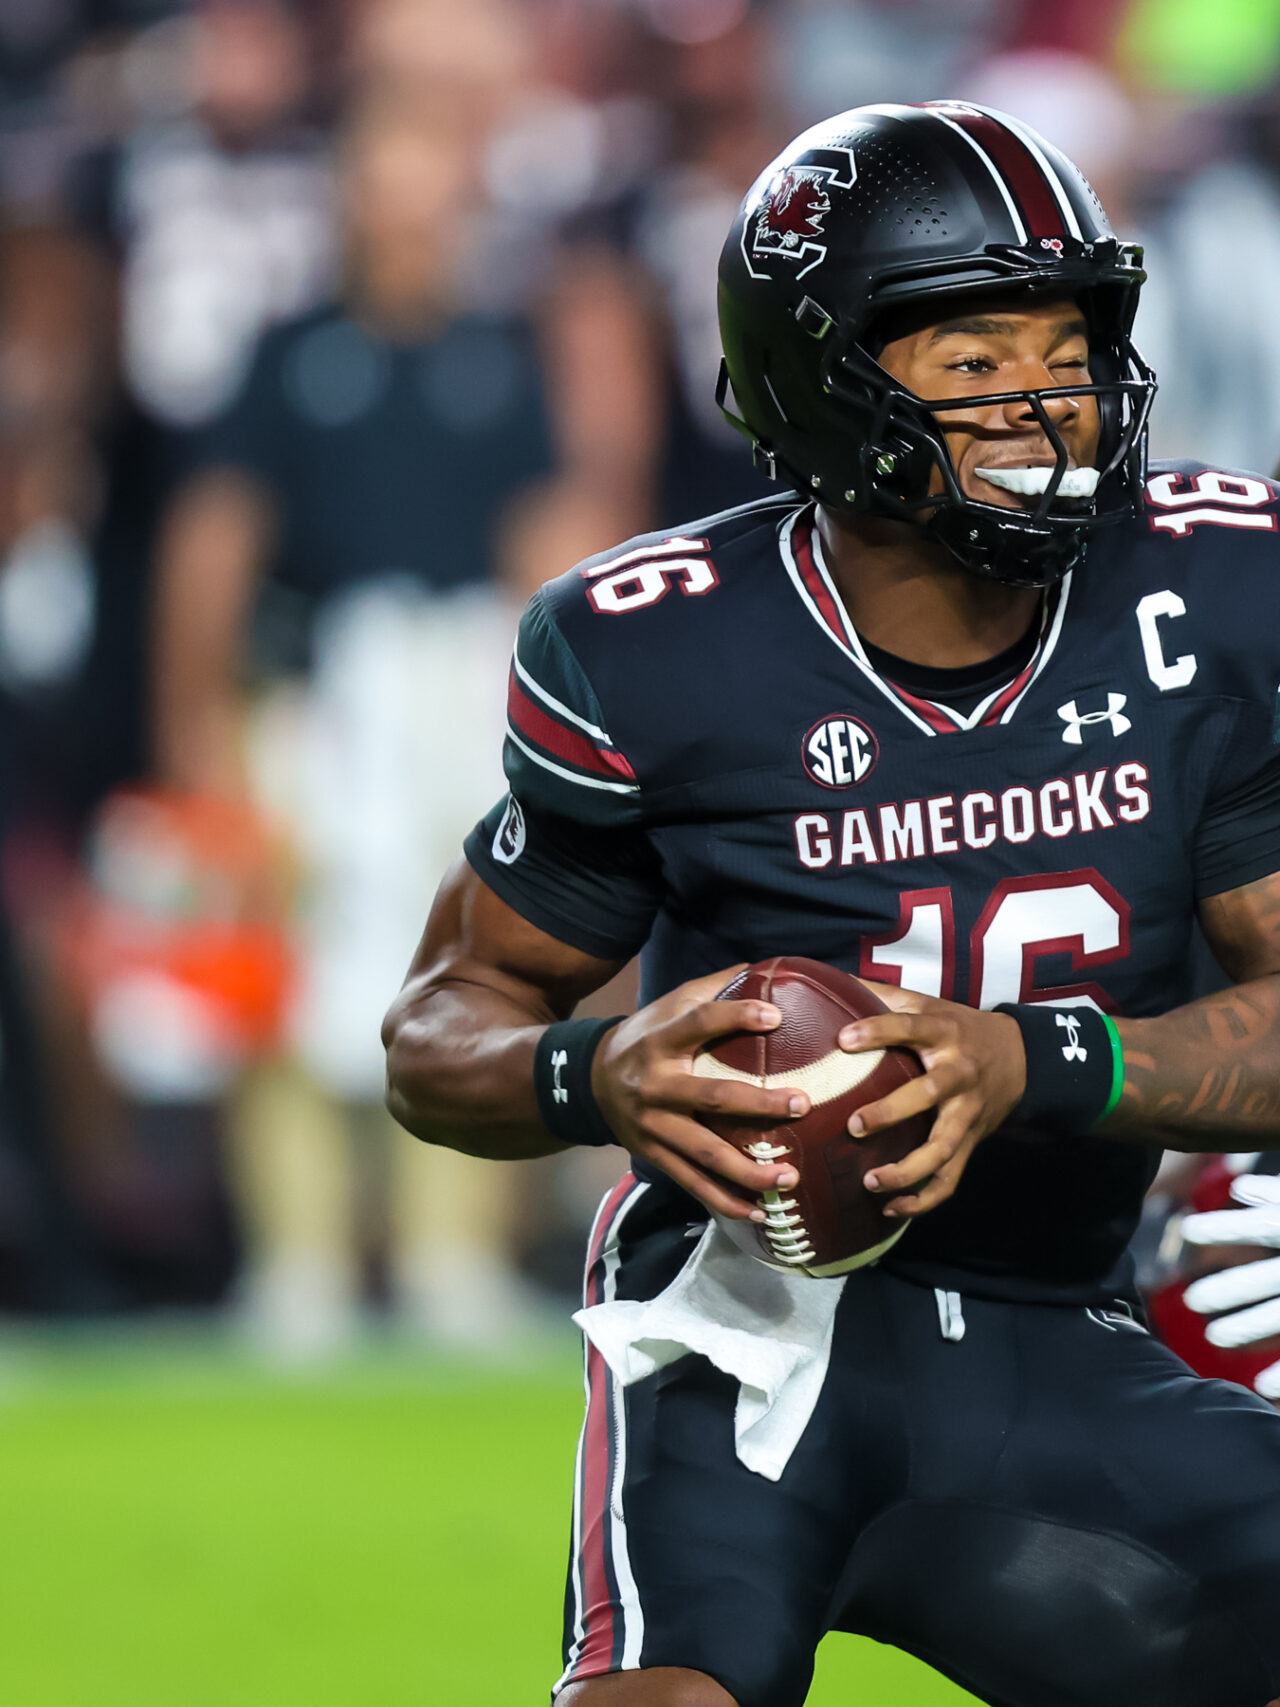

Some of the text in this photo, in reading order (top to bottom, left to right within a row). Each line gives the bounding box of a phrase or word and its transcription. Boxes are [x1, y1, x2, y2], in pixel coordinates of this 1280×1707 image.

[1146, 471, 1278, 538] 16
[581, 536, 720, 614] 16
[1136, 591, 1198, 692] C
[807, 720, 873, 785] SEC
[795, 762, 1151, 869] GAMECOCKS
[859, 868, 1131, 1014] 16
